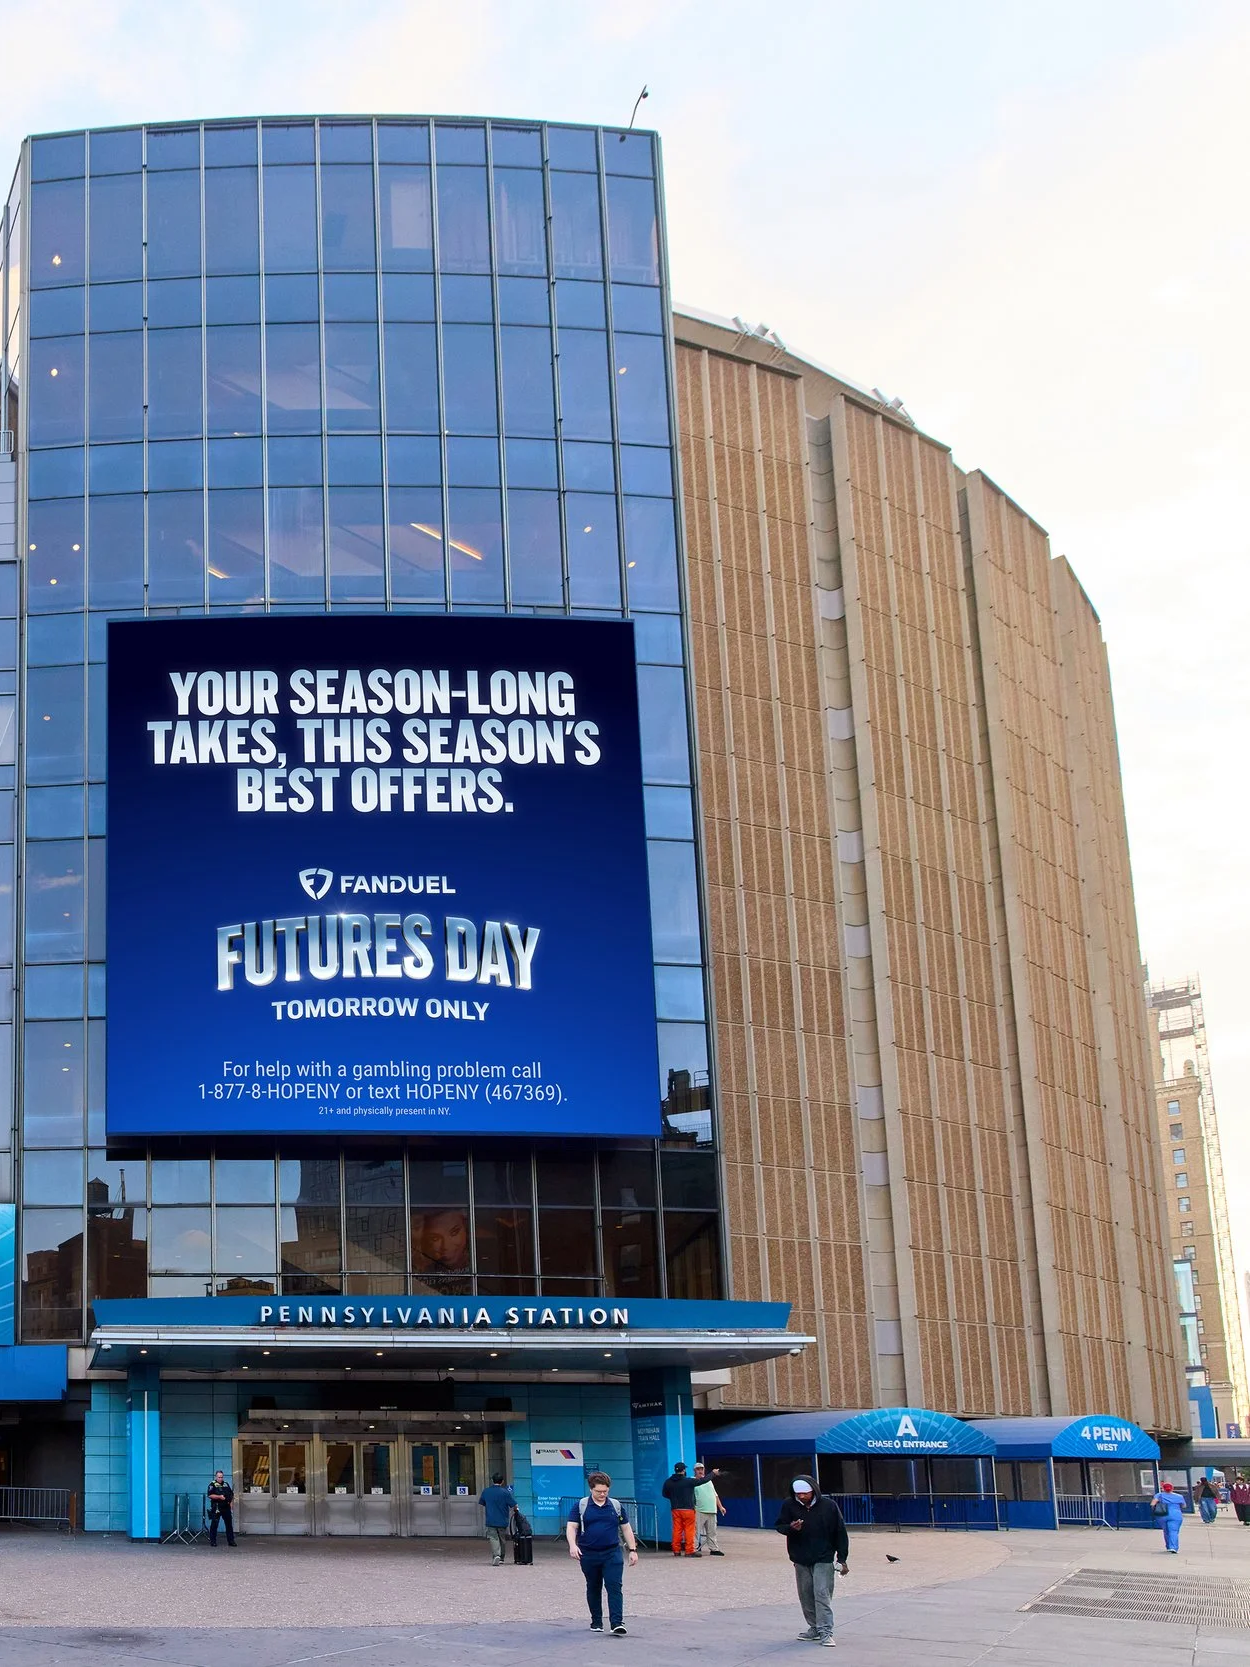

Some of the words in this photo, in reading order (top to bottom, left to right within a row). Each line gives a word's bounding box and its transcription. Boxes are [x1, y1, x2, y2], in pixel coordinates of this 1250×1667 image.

[169, 671, 279, 716] YOUR
[290, 669, 575, 716] SEASON-LONG
[147, 718, 287, 768] TAKES,
[297, 718, 392, 763] THIS
[402, 718, 601, 765] SEASON'S
[237, 767, 340, 812] BEST
[351, 767, 514, 813] OFFERS.
[340, 876, 456, 894] FANDUEL
[216, 912, 434, 991] FUTURES
[445, 916, 541, 990] DAY
[271, 997, 419, 1021] TOMORROW
[426, 999, 489, 1021] ONLY
[223, 1061, 250, 1077] For
[255, 1060, 291, 1080] help
[297, 1060, 332, 1077] with
[337, 1064, 347, 1077] a
[352, 1060, 431, 1081] gambling
[437, 1061, 506, 1081] problem
[512, 1062, 542, 1079] call
[198, 1083, 341, 1100] 1-877-8-HOPENY
[346, 1086, 363, 1099] or
[368, 1083, 400, 1099] text
[406, 1083, 479, 1100] HOPENY
[485, 1082, 568, 1105] (467369).
[318, 1106, 334, 1115] 21+
[336, 1106, 351, 1115] and
[353, 1106, 393, 1117] physically
[395, 1107, 426, 1116] present
[428, 1107, 436, 1115] in
[260, 1306, 491, 1325] PENNSYLVANIA
[506, 1307, 629, 1325] STATION
[896, 1415, 918, 1437] A
[1081, 1425, 1091, 1440] 4
[1093, 1426, 1132, 1441] PENN
[868, 1440, 893, 1448] CHASE
[1096, 1443, 1118, 1451] WEST
